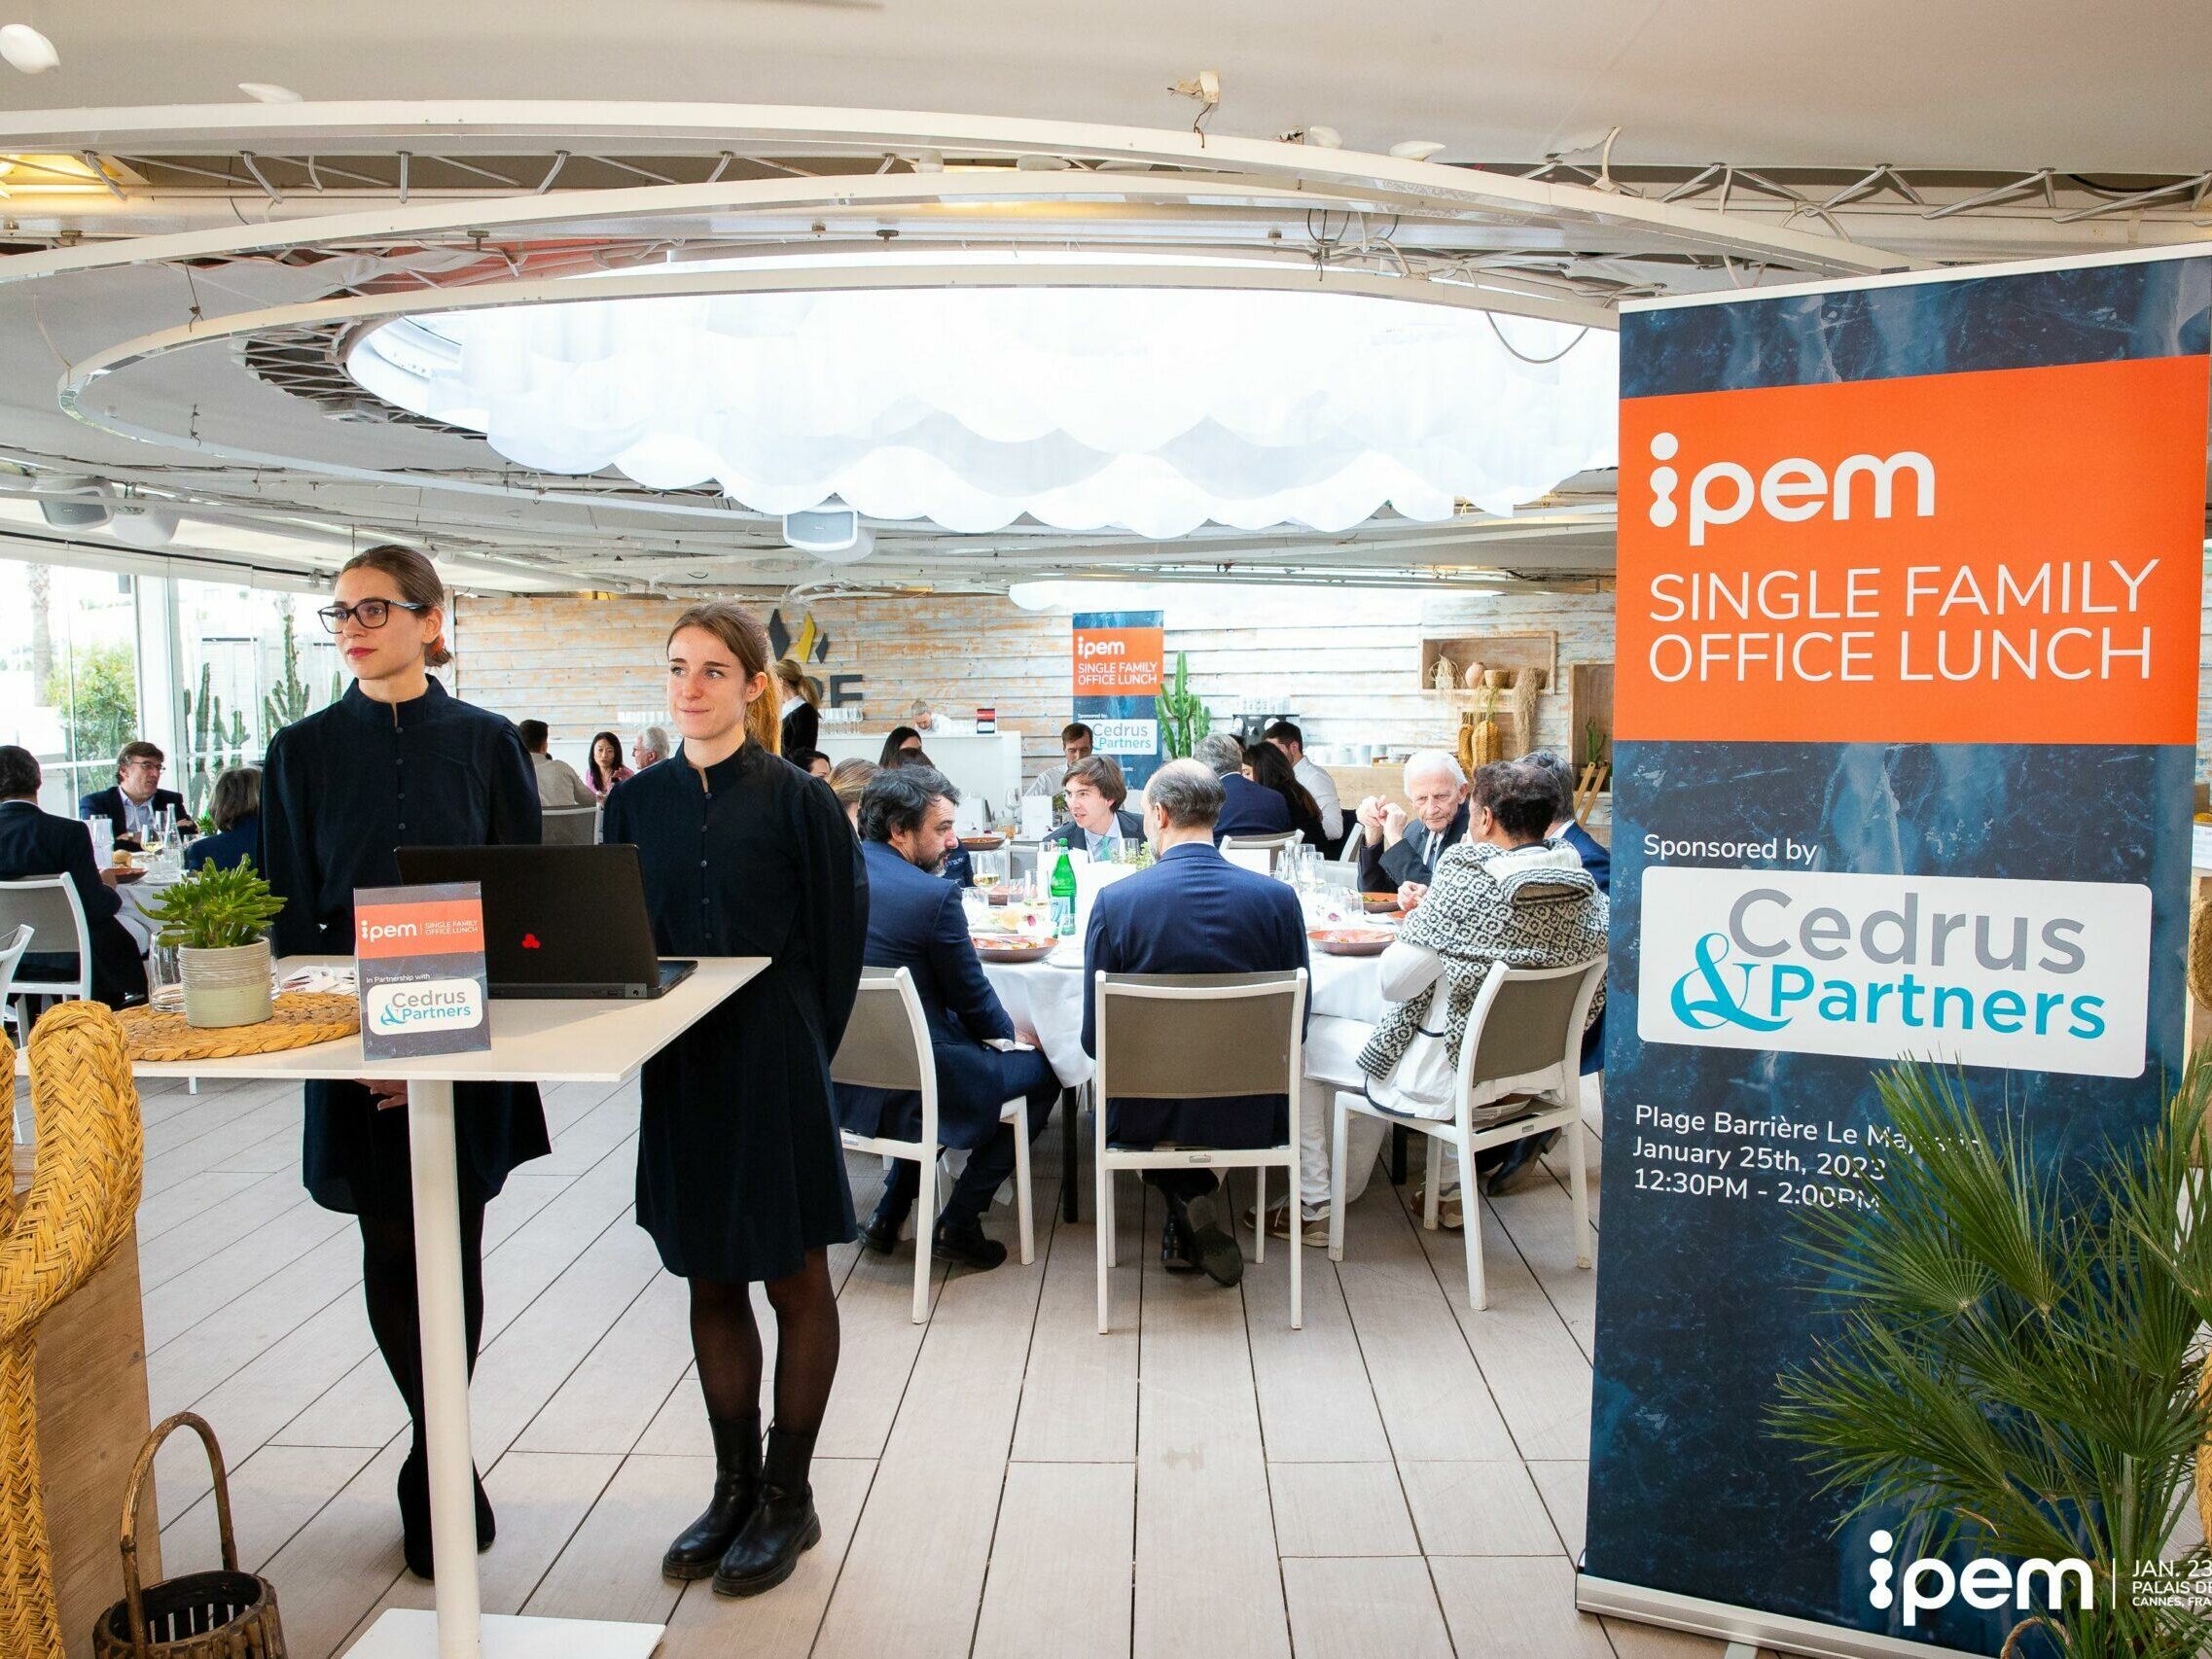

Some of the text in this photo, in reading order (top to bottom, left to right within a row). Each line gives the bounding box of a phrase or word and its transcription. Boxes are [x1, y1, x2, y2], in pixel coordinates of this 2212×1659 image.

[1649, 432, 1936, 547] ipem
[1649, 558, 2160, 622] SINGLE FAMILY
[1077, 635, 1125, 658] ipem
[1649, 626, 2153, 683] OFFICE LUNCH
[1078, 662, 1158, 674] SINGLE FAMILY
[1078, 674, 1158, 686] OFFICE LUNCH
[1092, 723, 1148, 737] Cedrus
[1099, 737, 1152, 749] Partners
[1643, 834, 1817, 865] Sponsored by
[361, 920, 418, 942] ipem
[1729, 888, 2087, 974] Cedrus
[374, 974, 414, 983] Partnership
[392, 990, 466, 1007] Cedrus
[1635, 1104, 1705, 1135] Plage
[1714, 1112, 1818, 1141] Barrière
[1828, 1120, 1858, 1145] Le
[1632, 1136, 1886, 1181] January 25th, 2023
[1634, 1168, 1748, 1199] 12:30PM
